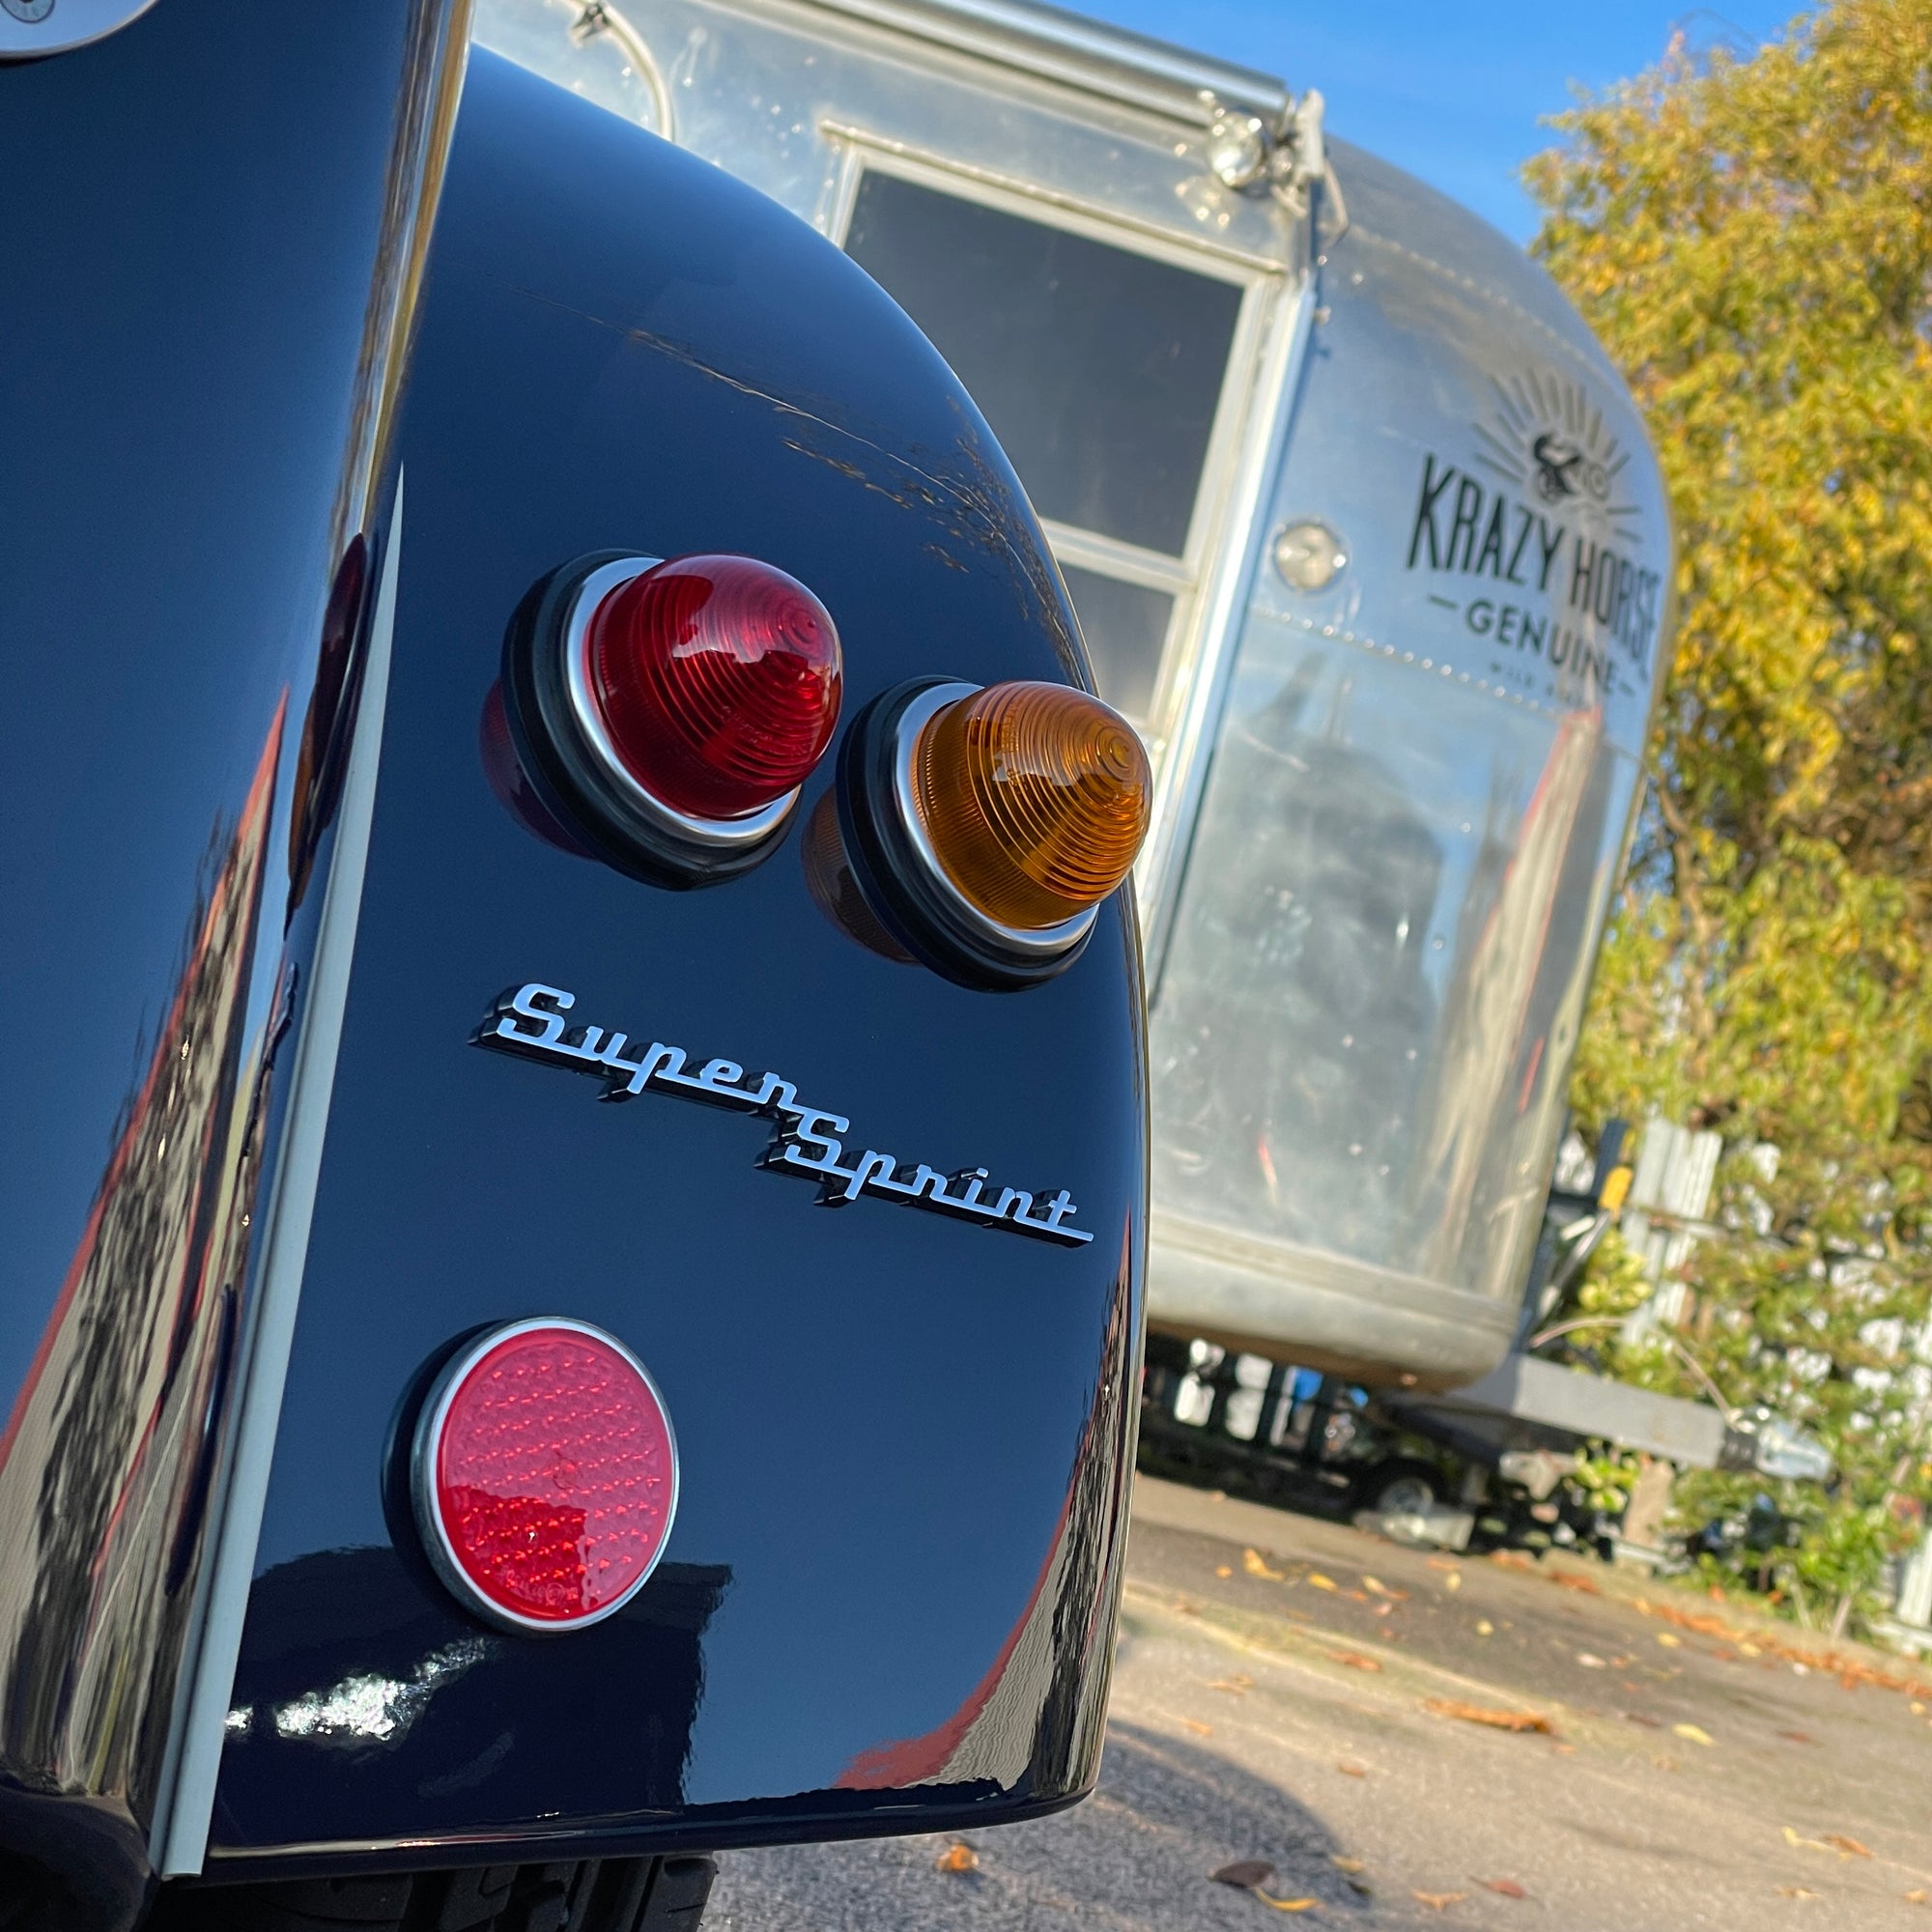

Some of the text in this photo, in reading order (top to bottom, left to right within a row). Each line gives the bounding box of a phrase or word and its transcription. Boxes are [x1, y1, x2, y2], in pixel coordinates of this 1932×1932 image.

[1407, 453, 1564, 591] KRAZY
[497, 982, 1094, 1242] Super Sprint
